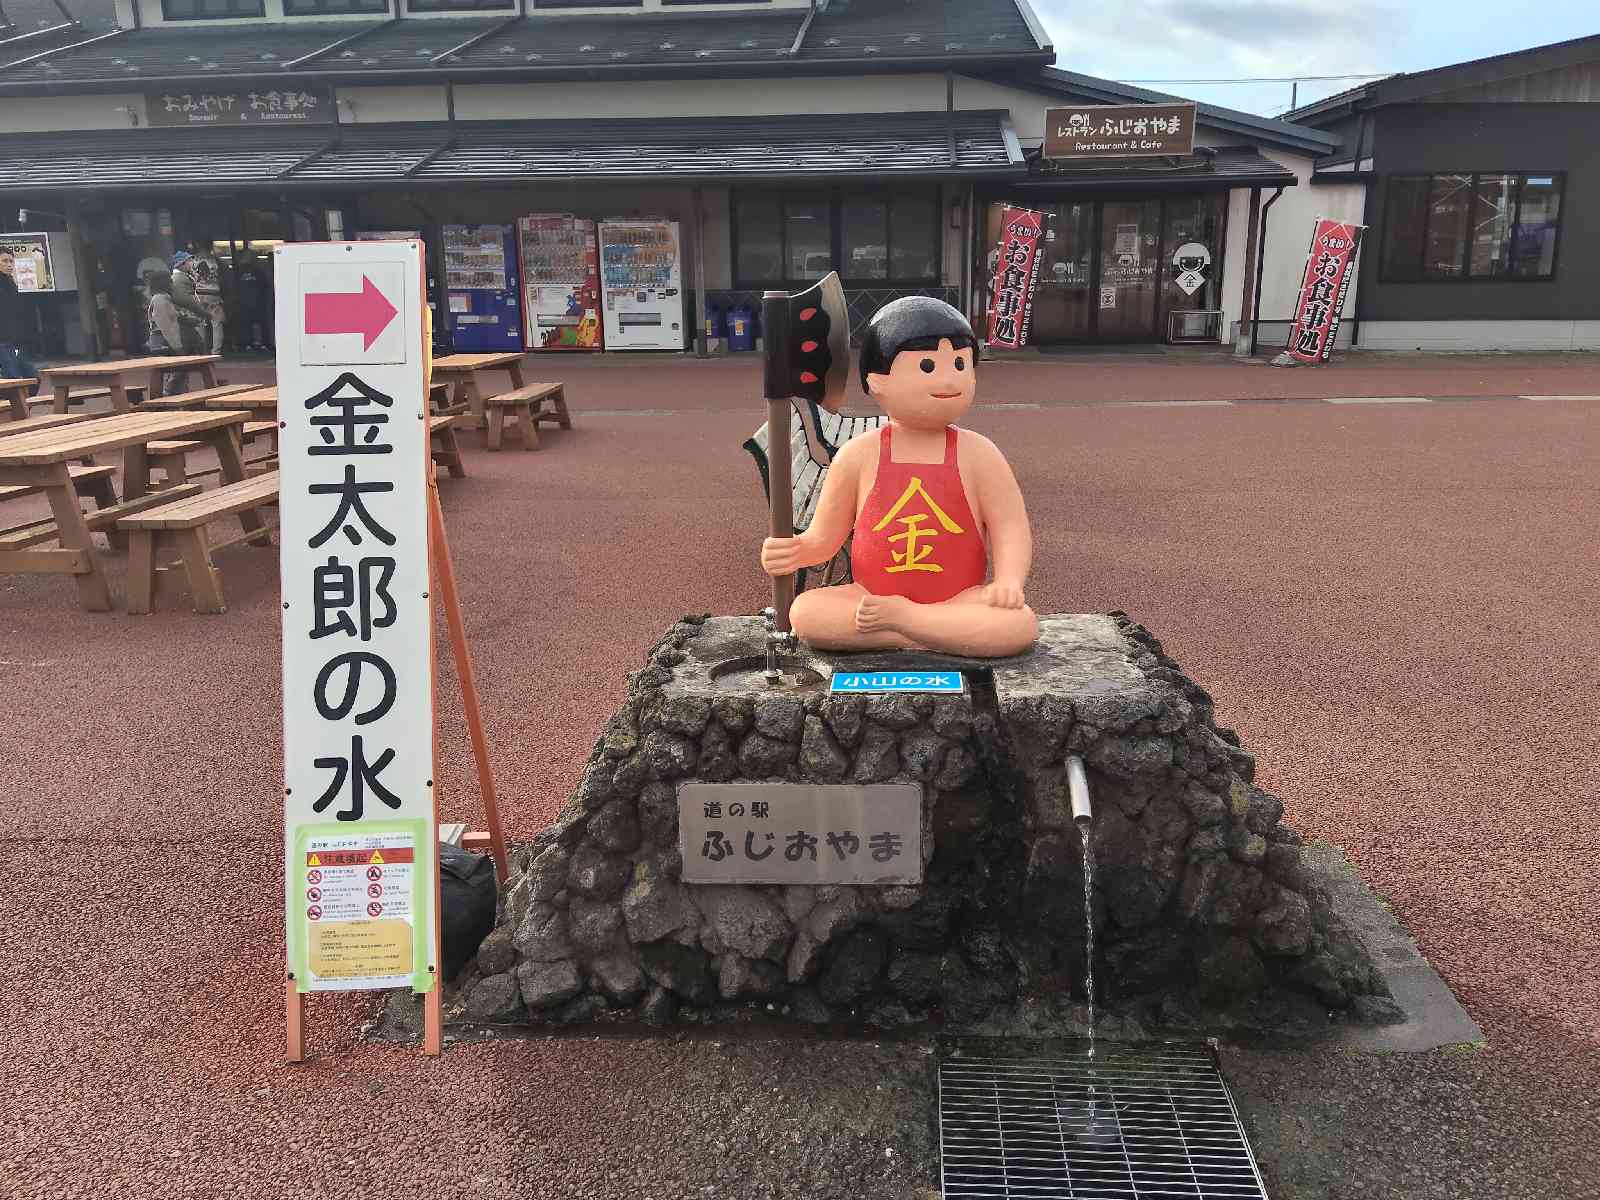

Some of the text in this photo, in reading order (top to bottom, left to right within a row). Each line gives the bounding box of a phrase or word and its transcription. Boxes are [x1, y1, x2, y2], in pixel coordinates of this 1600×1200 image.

[1057, 115, 1181, 137] レストラン ふじおやま
[1075, 139, 1162, 151] Restaurant & Cafe
[991, 240, 1030, 344] お食事処
[1183, 273, 1197, 288] 金
[1296, 251, 1341, 356] お食事処
[871, 476, 965, 573] 金
[304, 371, 402, 822] 金太郎の水
[842, 676, 951, 687] 小山の水
[703, 801, 769, 818] 道の駅
[701, 830, 903, 862] ふじおやま
